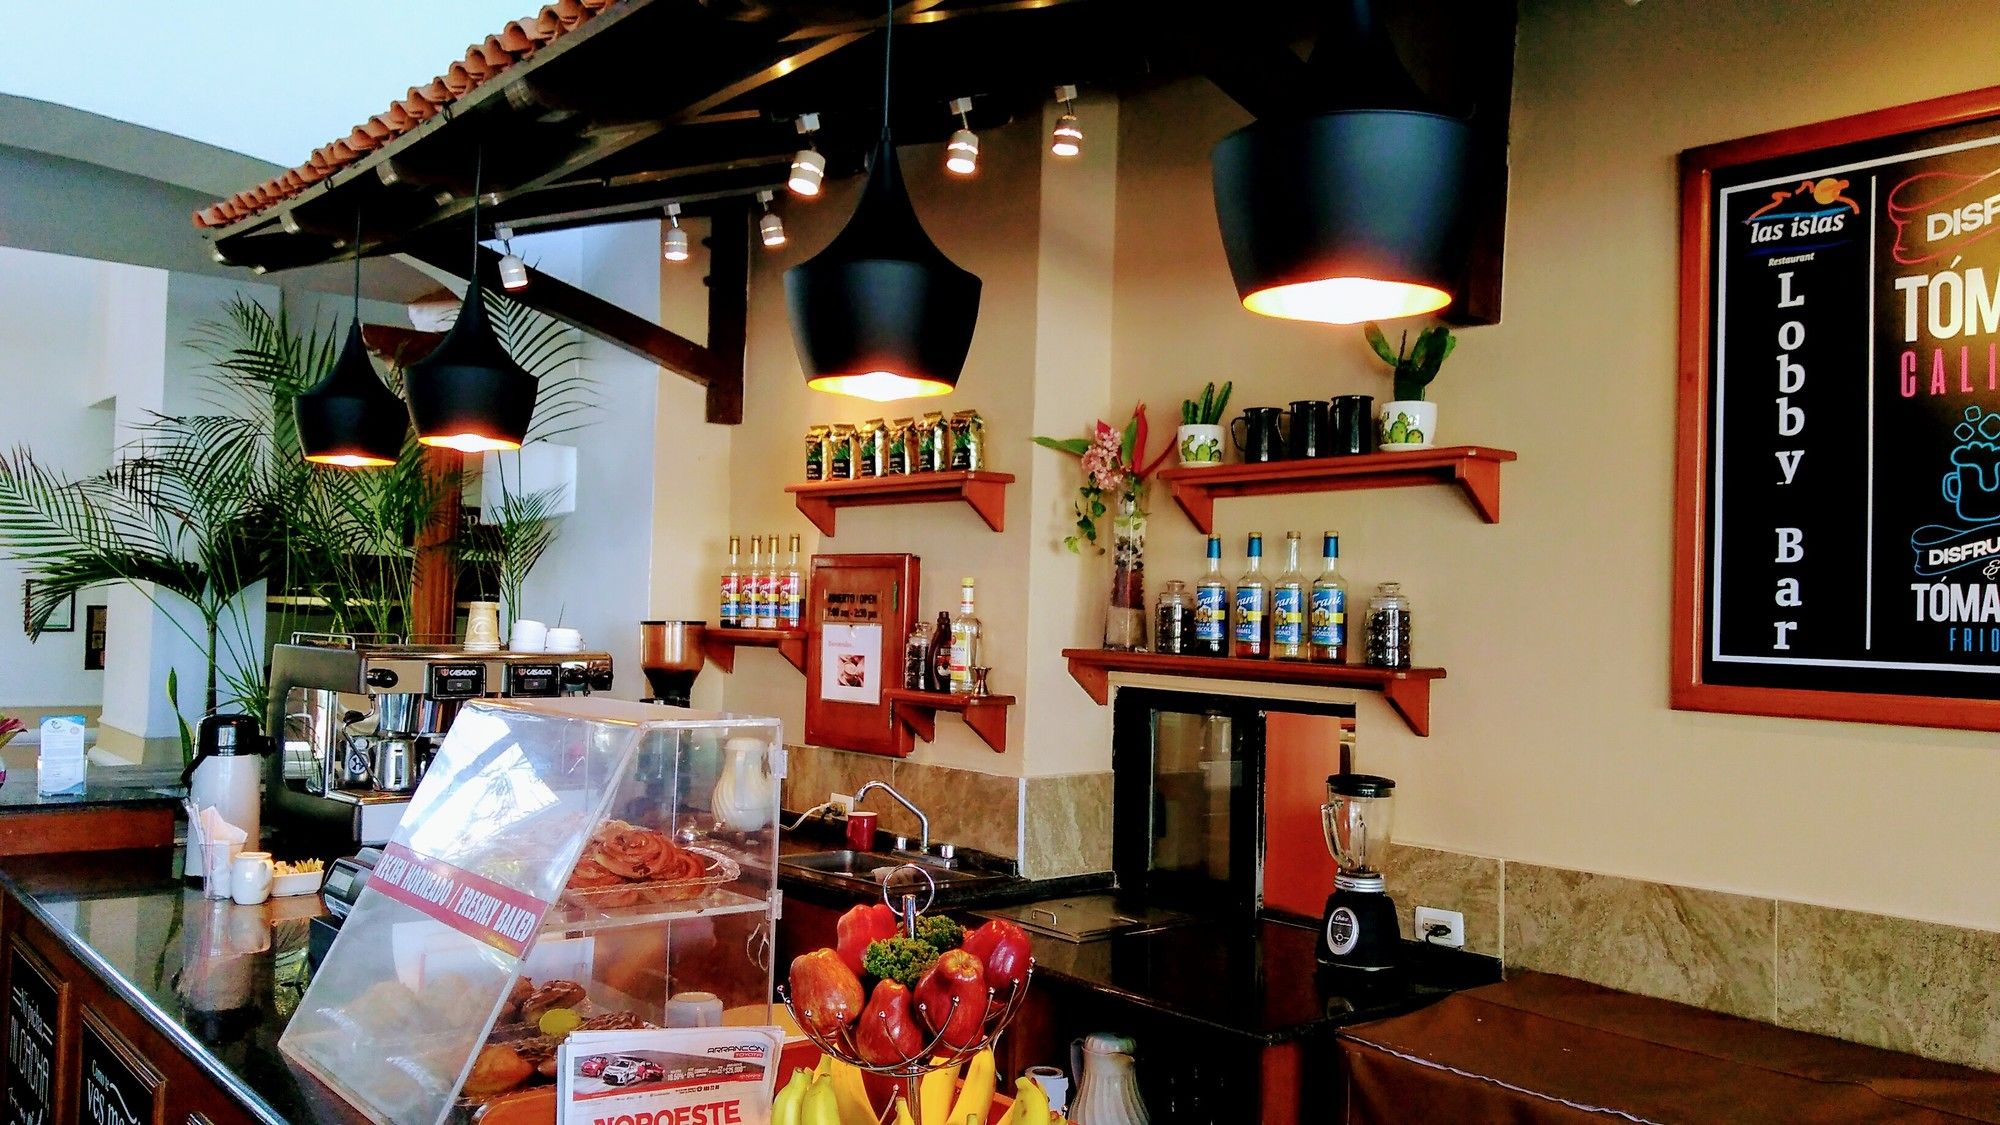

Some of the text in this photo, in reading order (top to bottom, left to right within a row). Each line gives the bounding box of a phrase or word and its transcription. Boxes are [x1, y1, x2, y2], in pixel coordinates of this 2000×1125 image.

[1750, 214, 1845, 244] las islas
[1926, 194, 2000, 242] DISF
[1768, 253, 1815, 267] Restaurant
[1895, 255, 2000, 343] TÓM
[1901, 343, 1996, 398] CALI
[1773, 272, 1806, 650] Lobby Bar
[1928, 537, 2000, 566] DISFRU
[1911, 576, 2000, 623] TÓMA
[374, 854, 410, 886] RECIEN
[402, 863, 455, 907] HORNEADO
[454, 886, 502, 928] FRESHLY
[493, 903, 537, 943] BAKED
[707, 1044, 765, 1054] ARRANCÓN
[594, 1100, 742, 1125] ROESTE
